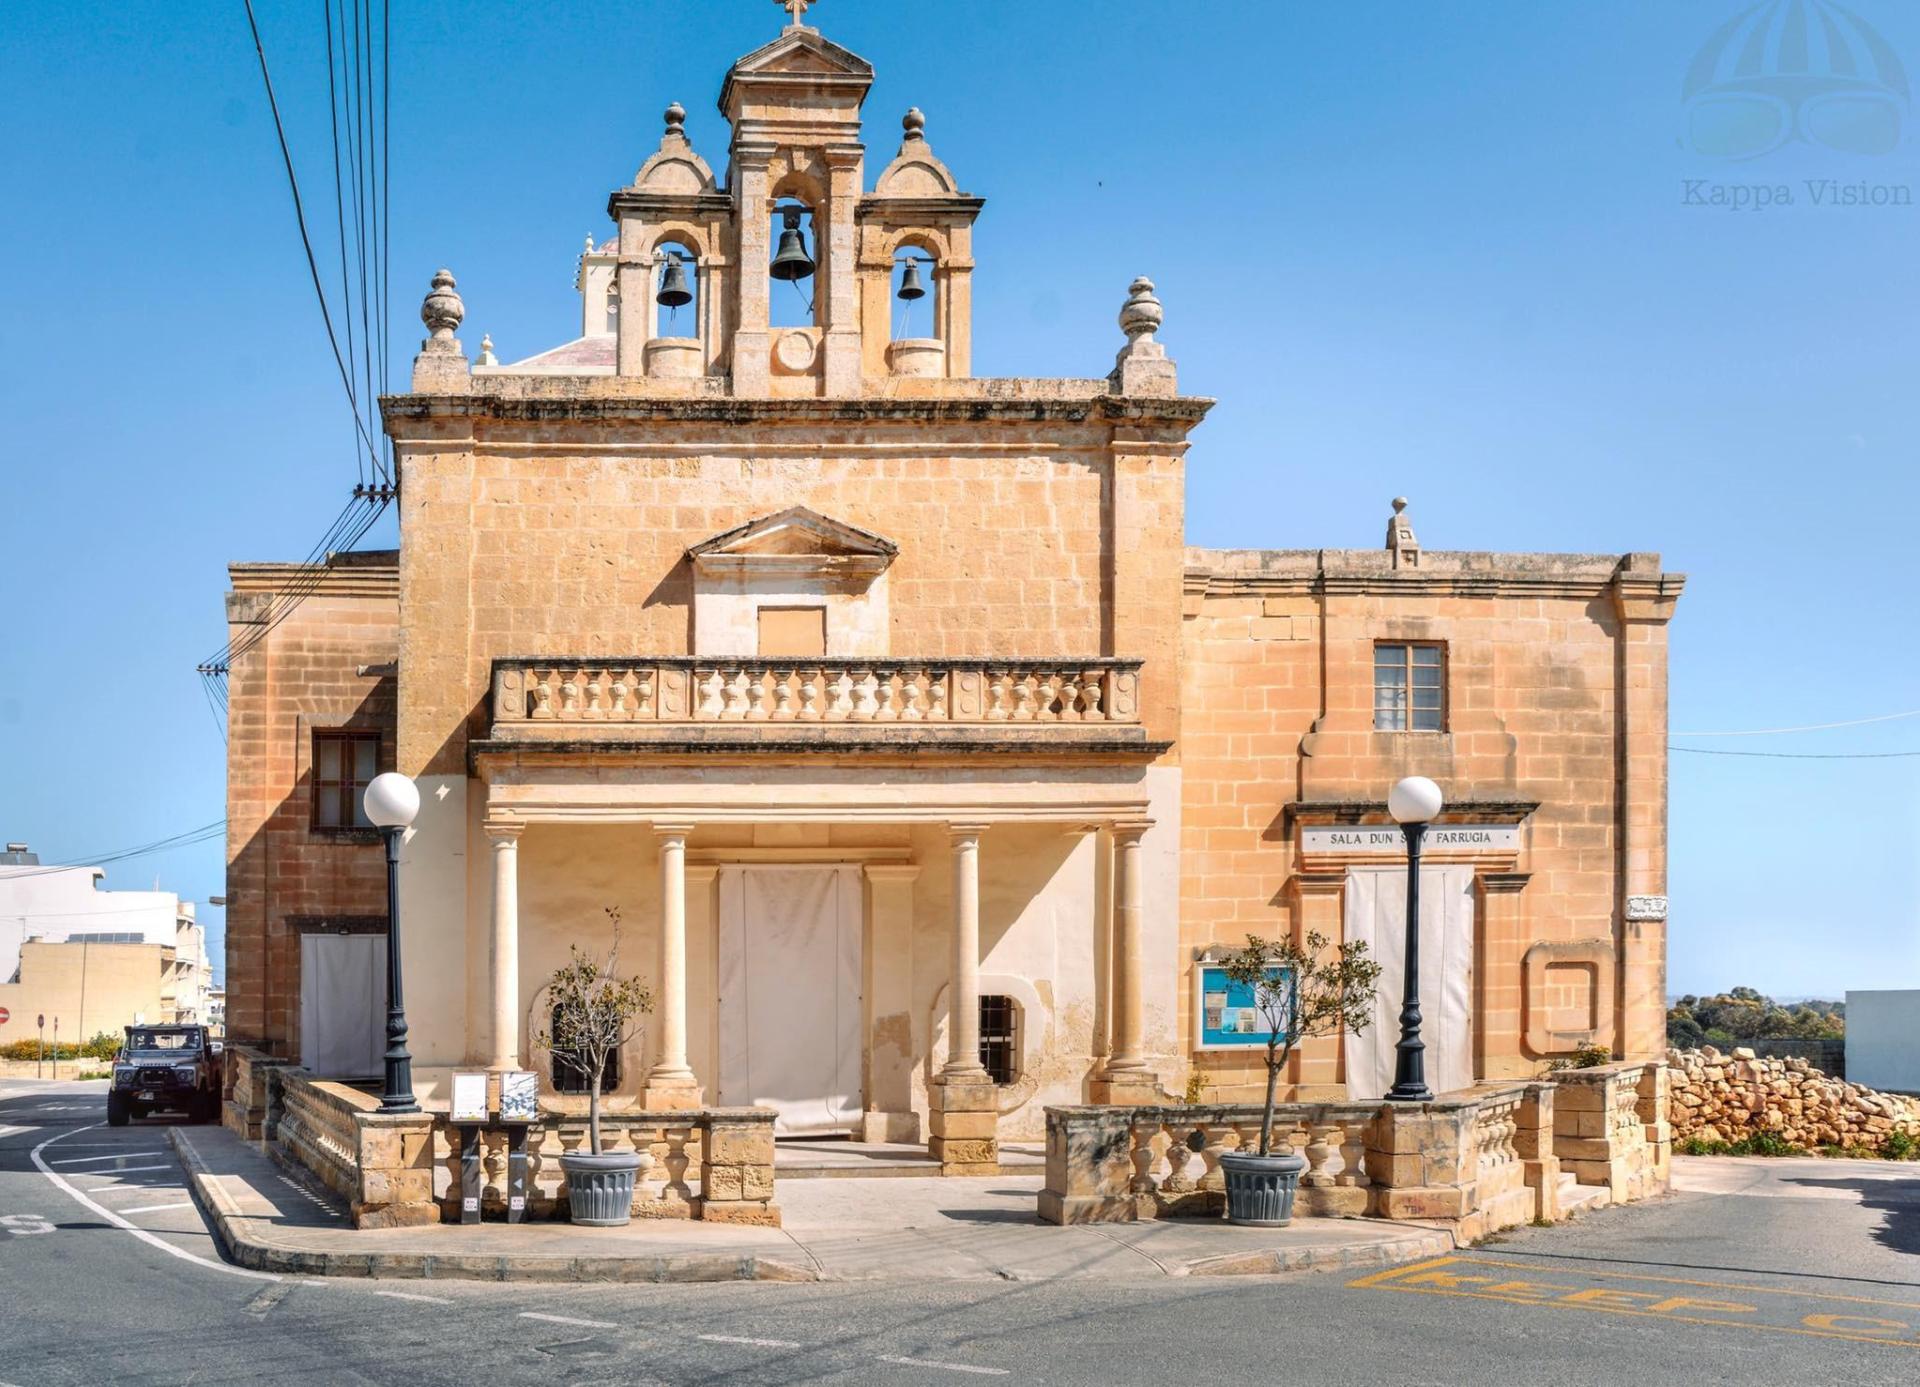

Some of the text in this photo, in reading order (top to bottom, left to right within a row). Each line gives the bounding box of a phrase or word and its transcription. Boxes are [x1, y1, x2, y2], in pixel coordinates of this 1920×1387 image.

[1330, 831, 1491, 844] SALA DUN SV FARRUGIA
[1400, 1270, 1920, 1340] KEEP C
